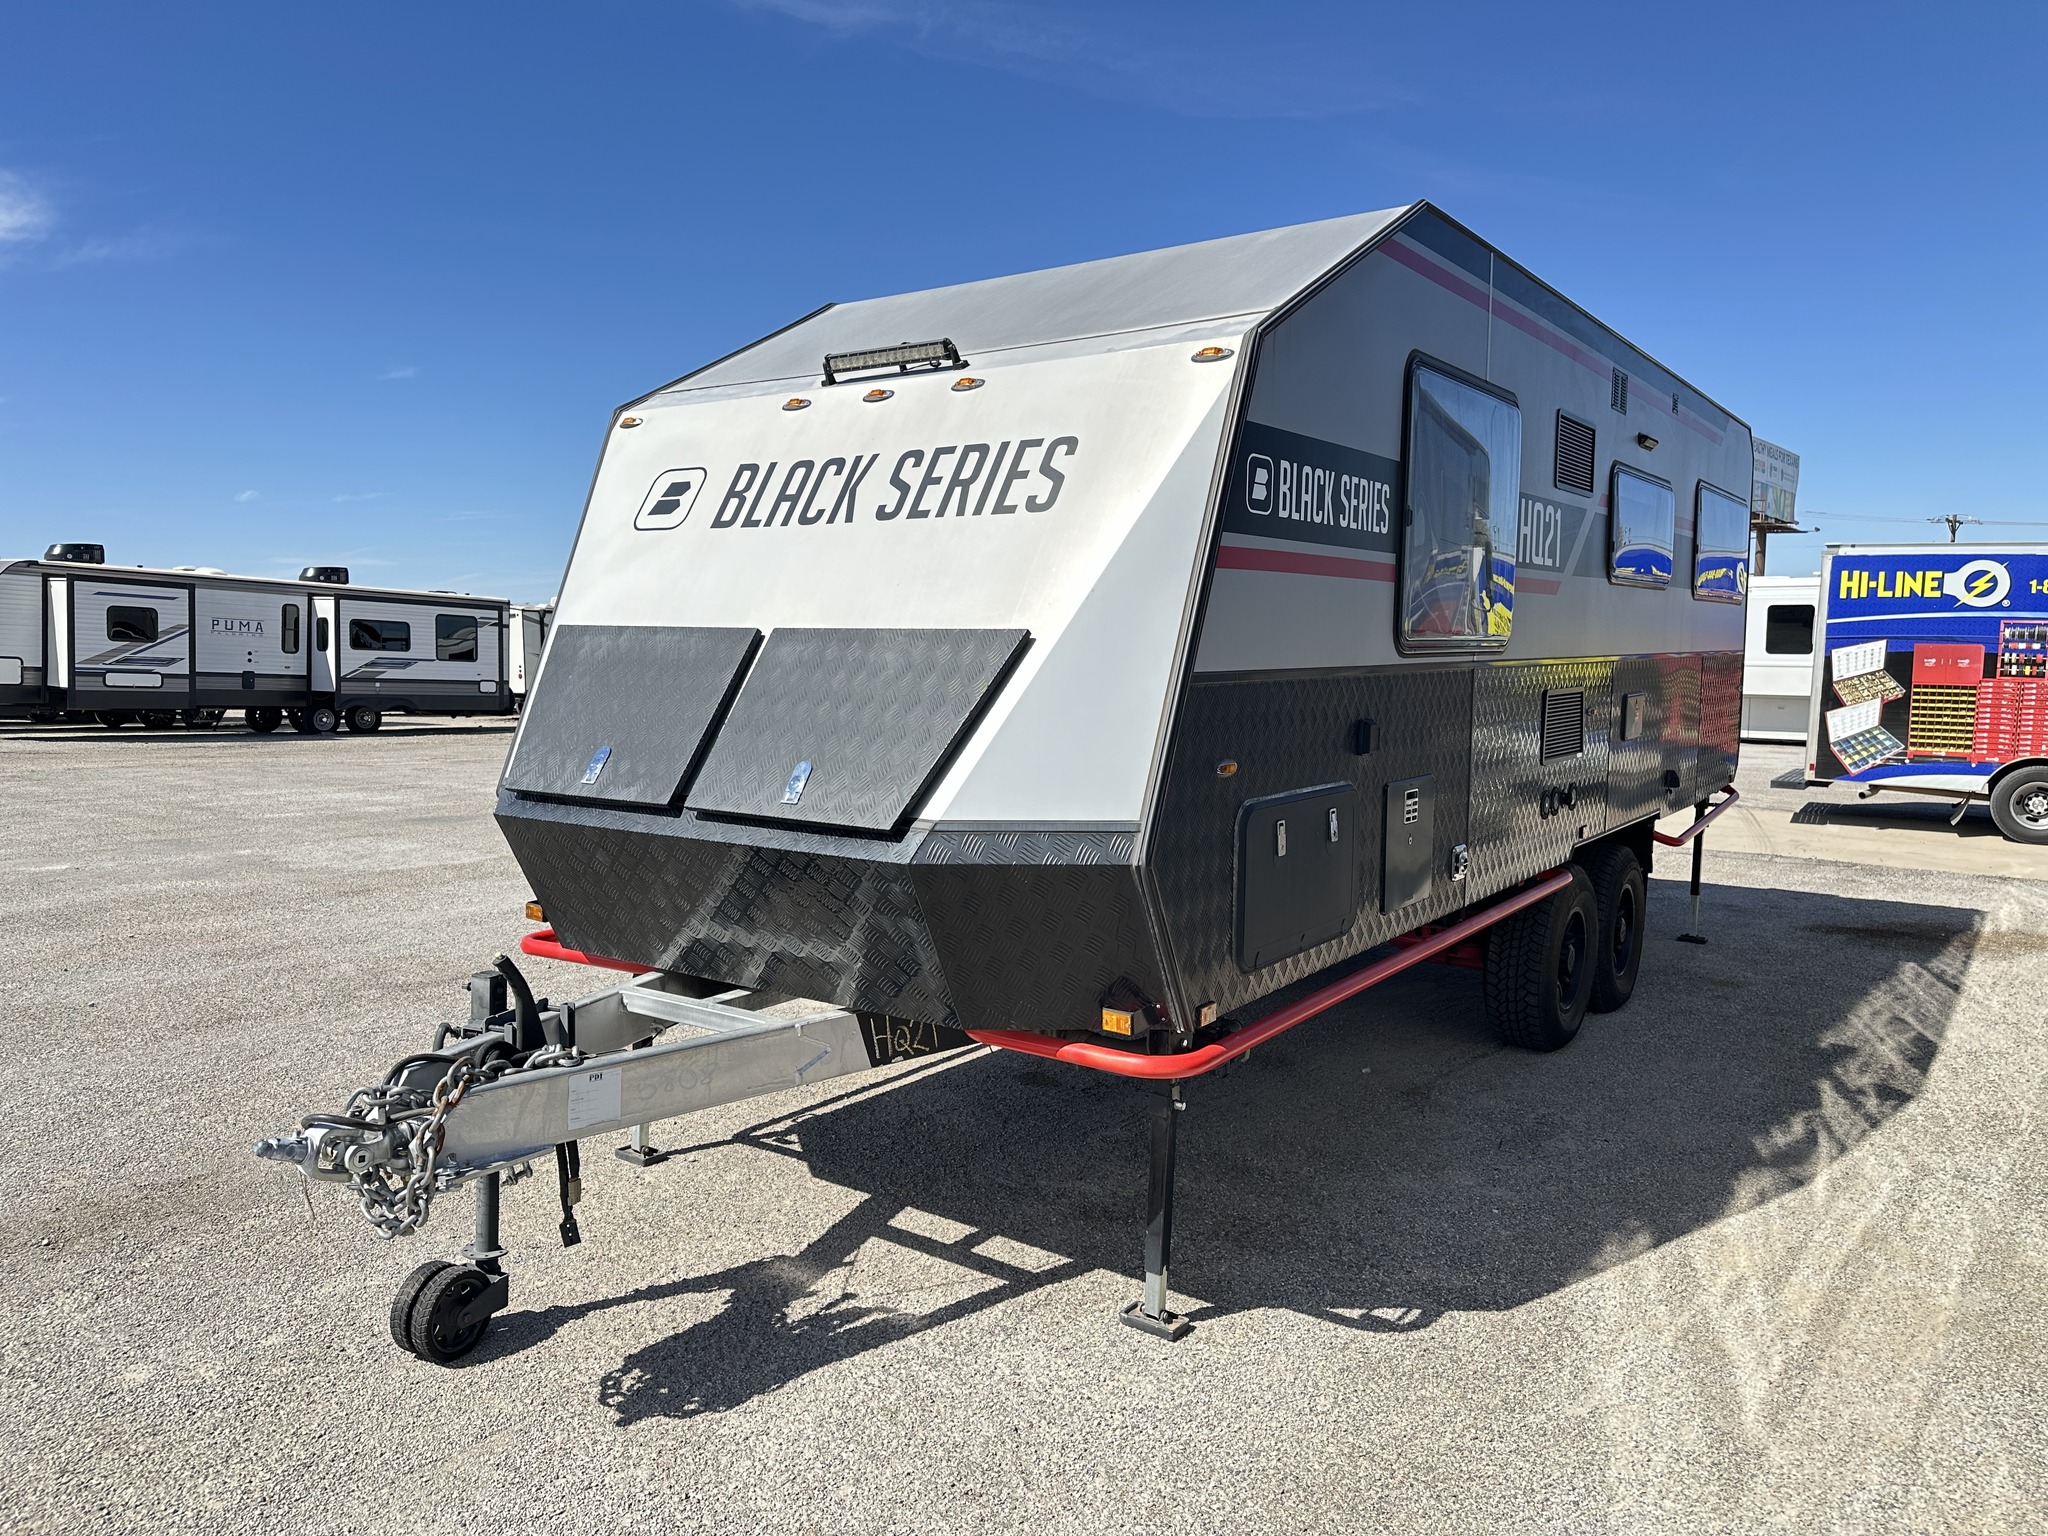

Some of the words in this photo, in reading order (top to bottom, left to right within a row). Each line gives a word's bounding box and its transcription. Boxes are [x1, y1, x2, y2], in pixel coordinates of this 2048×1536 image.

[710, 452, 880, 529] BLACK
[875, 435, 1079, 522] SERIES
[1278, 459, 1336, 526] BLACK
[1339, 474, 1390, 534] SERIES
[1518, 498, 1562, 568] HQ21
[1839, 570, 1944, 599] HI-LINE
[211, 619, 264, 632] PUMA
[870, 1015, 939, 1059] HQ21
[588, 1072, 604, 1082] PDI
